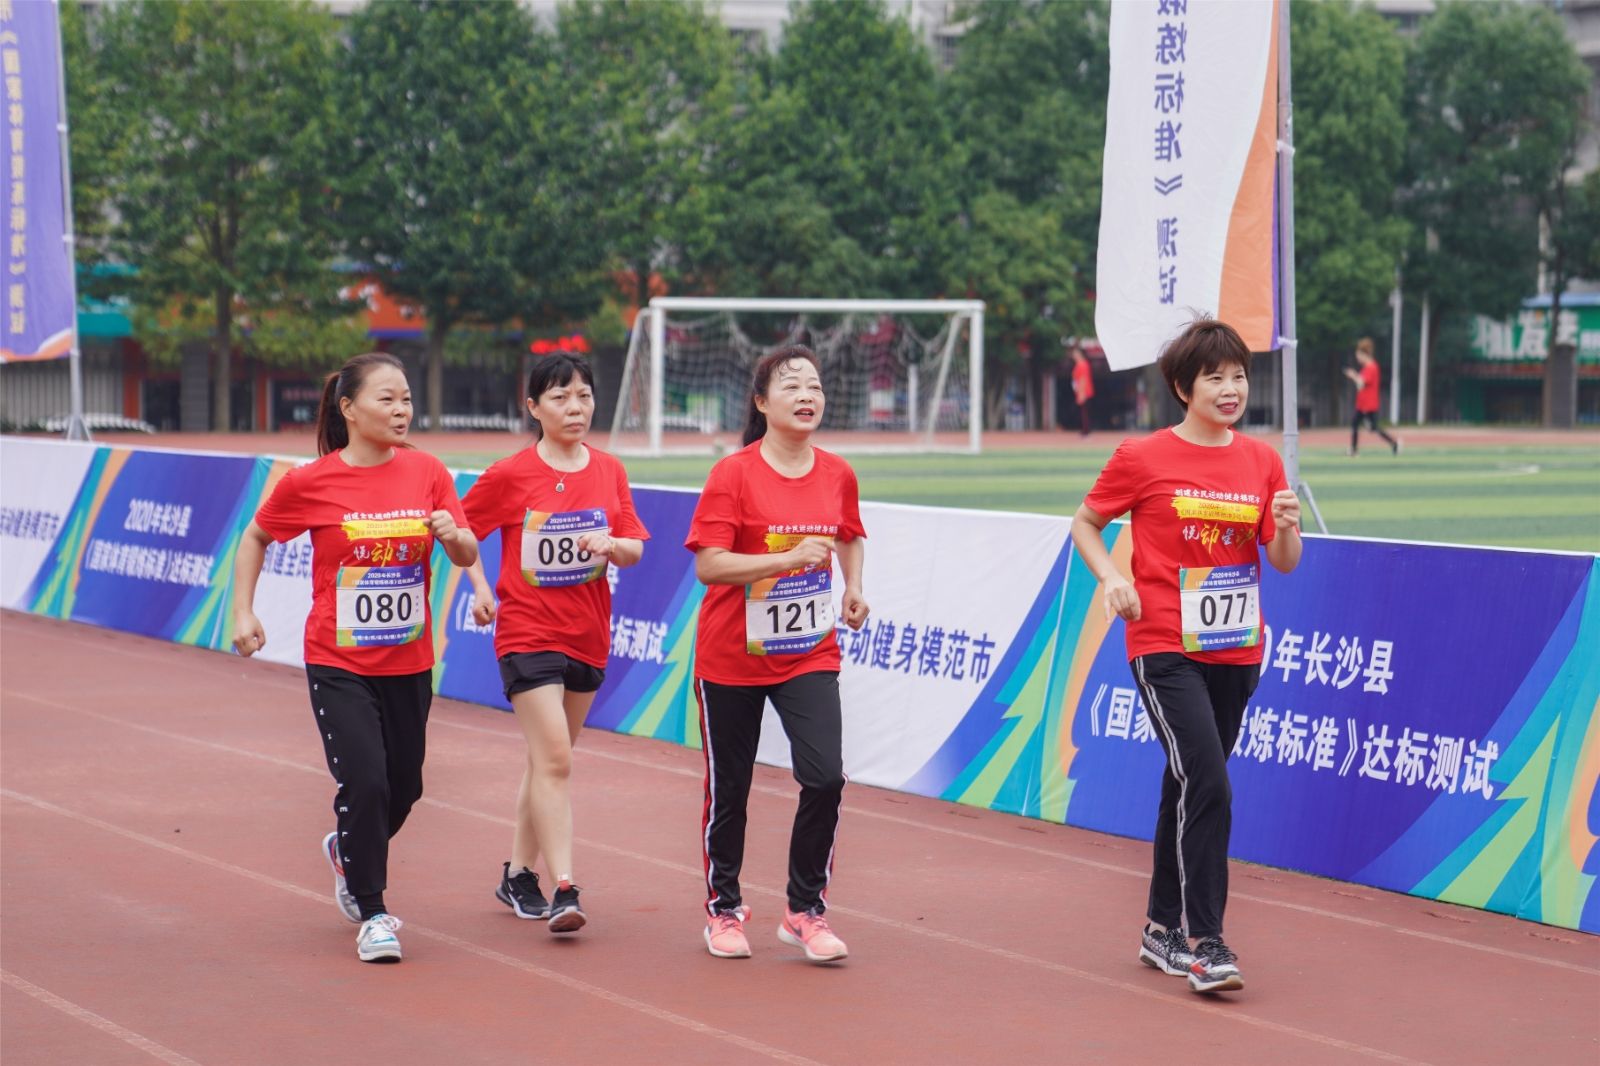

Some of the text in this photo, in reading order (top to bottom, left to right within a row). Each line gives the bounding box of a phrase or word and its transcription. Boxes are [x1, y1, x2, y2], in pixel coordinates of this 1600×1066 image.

[355, 592, 412, 624] 080
[766, 599, 818, 634] 121
[1200, 592, 1248, 627] 077
[610, 614, 668, 665] 标测试
[1231, 704, 1499, 800] 炼标准》达标测试
